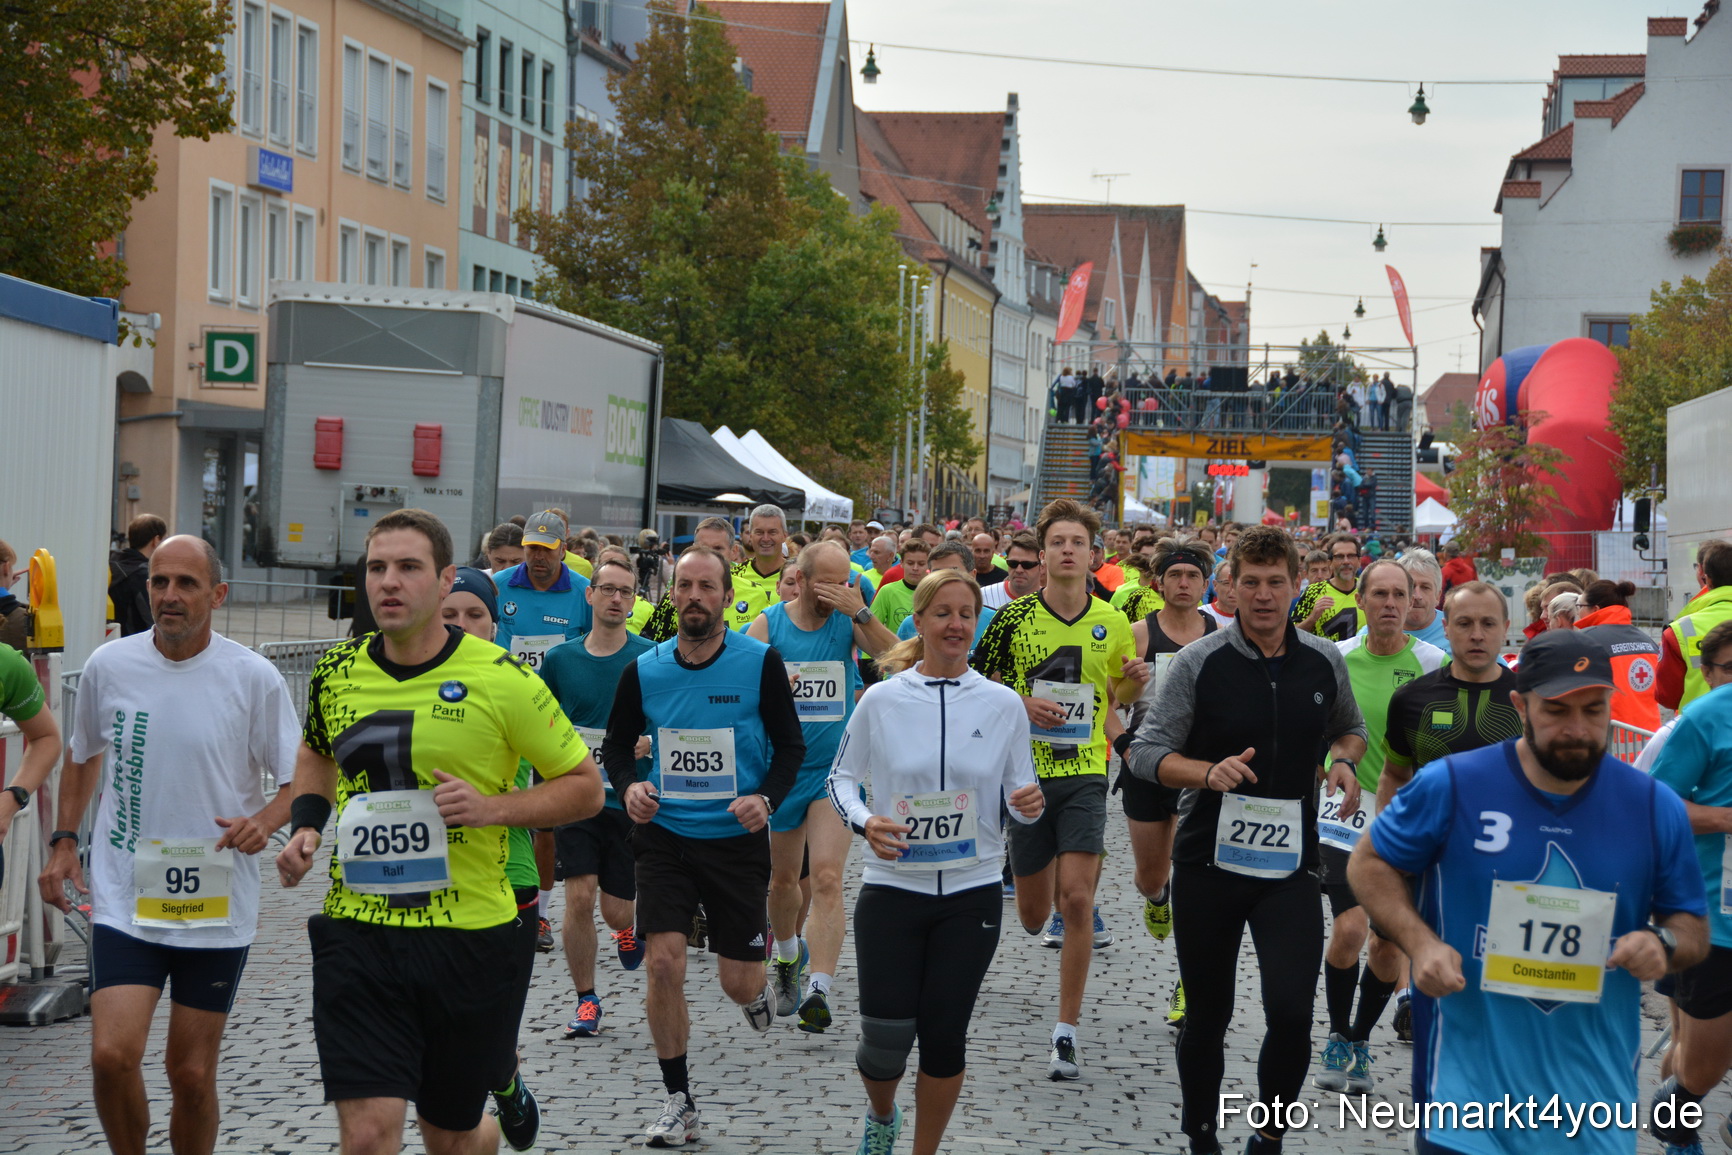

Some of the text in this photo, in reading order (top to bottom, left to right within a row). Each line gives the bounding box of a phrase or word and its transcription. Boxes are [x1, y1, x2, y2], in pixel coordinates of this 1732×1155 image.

[213, 339, 250, 376] D
[605, 399, 647, 459] BOCK
[423, 487, 437, 495] NM
[542, 615, 569, 625] BOCK
[793, 680, 837, 698] 2570
[708, 695, 741, 704] THULE
[432, 704, 465, 718] Partl
[800, 704, 829, 712] Hermann
[670, 750, 724, 773] 2653
[686, 780, 710, 788] Marco
[375, 800, 411, 811] BOCK
[1320, 801, 1366, 829] 226
[905, 813, 964, 840] 2767
[1230, 820, 1290, 848] 2722
[1474, 811, 1513, 852] 3
[353, 822, 430, 856] 2659
[170, 846, 206, 856] BOCK
[911, 846, 956, 858] Kristina
[383, 865, 405, 877] Ralf
[166, 867, 200, 894] 95
[162, 903, 204, 916] Siegfried
[1538, 898, 1580, 911] BOCK
[1519, 918, 1582, 958] 178
[1513, 963, 1577, 982] Constantin
